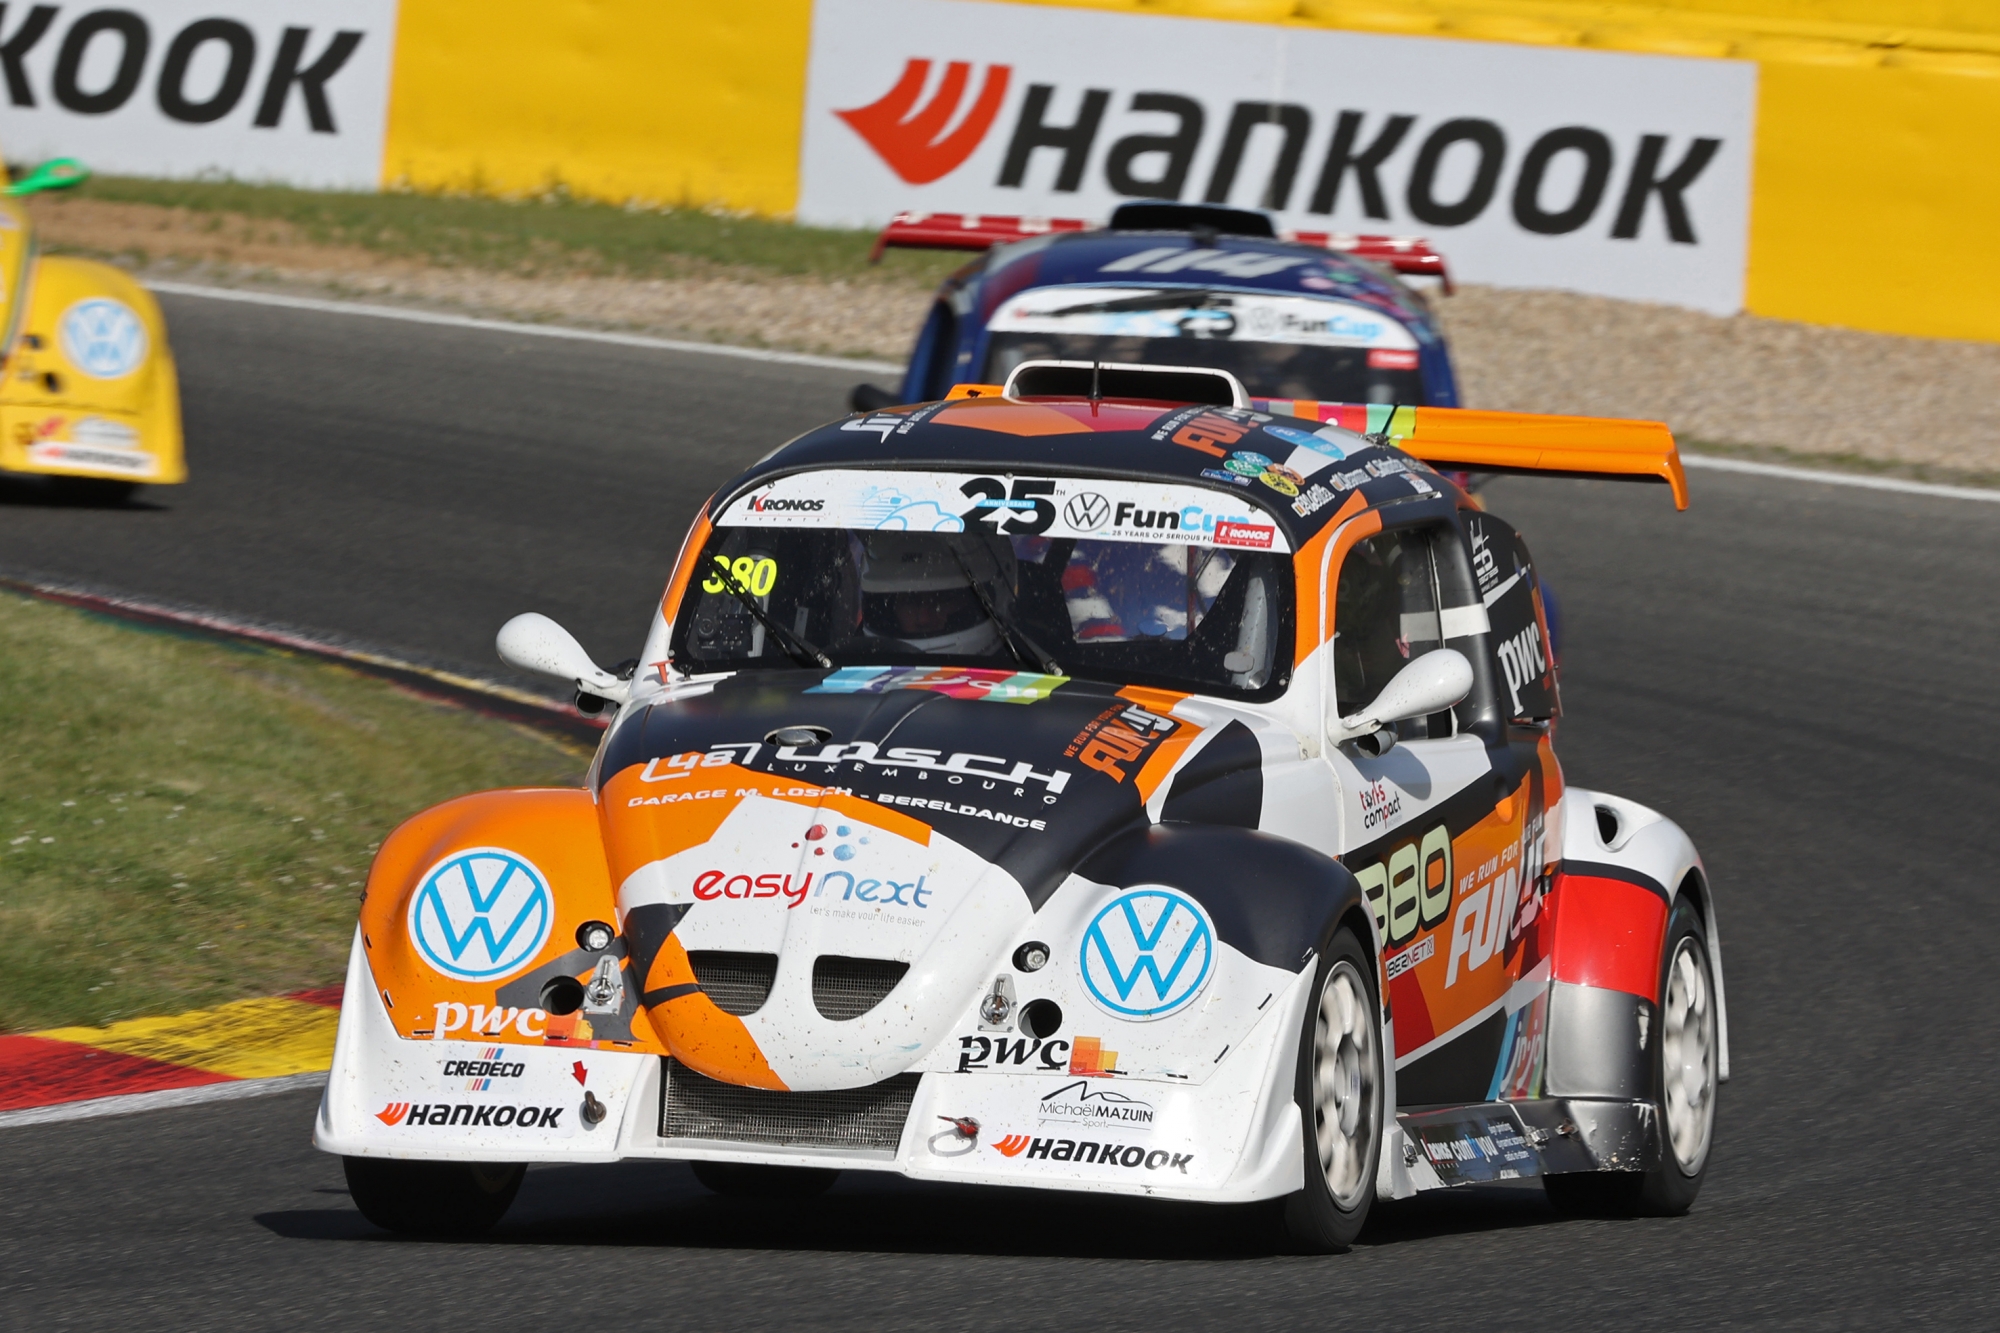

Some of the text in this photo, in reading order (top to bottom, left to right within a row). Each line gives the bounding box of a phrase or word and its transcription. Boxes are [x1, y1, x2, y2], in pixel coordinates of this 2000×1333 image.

[747, 491, 825, 512] KRONOS
[984, 500, 1032, 508] ANNIVERSARY
[1114, 502, 1249, 532] FunCu
[1125, 531, 1149, 539] YEARS
[1219, 524, 1270, 541] KRONOS
[1497, 621, 1546, 717] pwc
[1063, 744, 1079, 758] WE
[1073, 730, 1090, 746] RUN
[1085, 720, 1102, 733] FOR
[775, 741, 1072, 795] LOSCH
[627, 789, 727, 807] GARAGE
[772, 786, 853, 797] LOSCH
[877, 793, 1047, 831] BERELDANGE
[1364, 790, 1402, 829] compact
[1353, 824, 1452, 947] 380
[1459, 870, 1475, 896] WE
[1477, 854, 1499, 884] RUN
[1500, 839, 1519, 867] FOR
[810, 905, 830, 917] Let's
[832, 909, 856, 920] make
[880, 912, 895, 923] life
[897, 915, 925, 927] easier
[433, 1001, 547, 1040] pwc
[443, 1060, 526, 1079] CREDECO
[954, 1035, 1071, 1074] pwc
